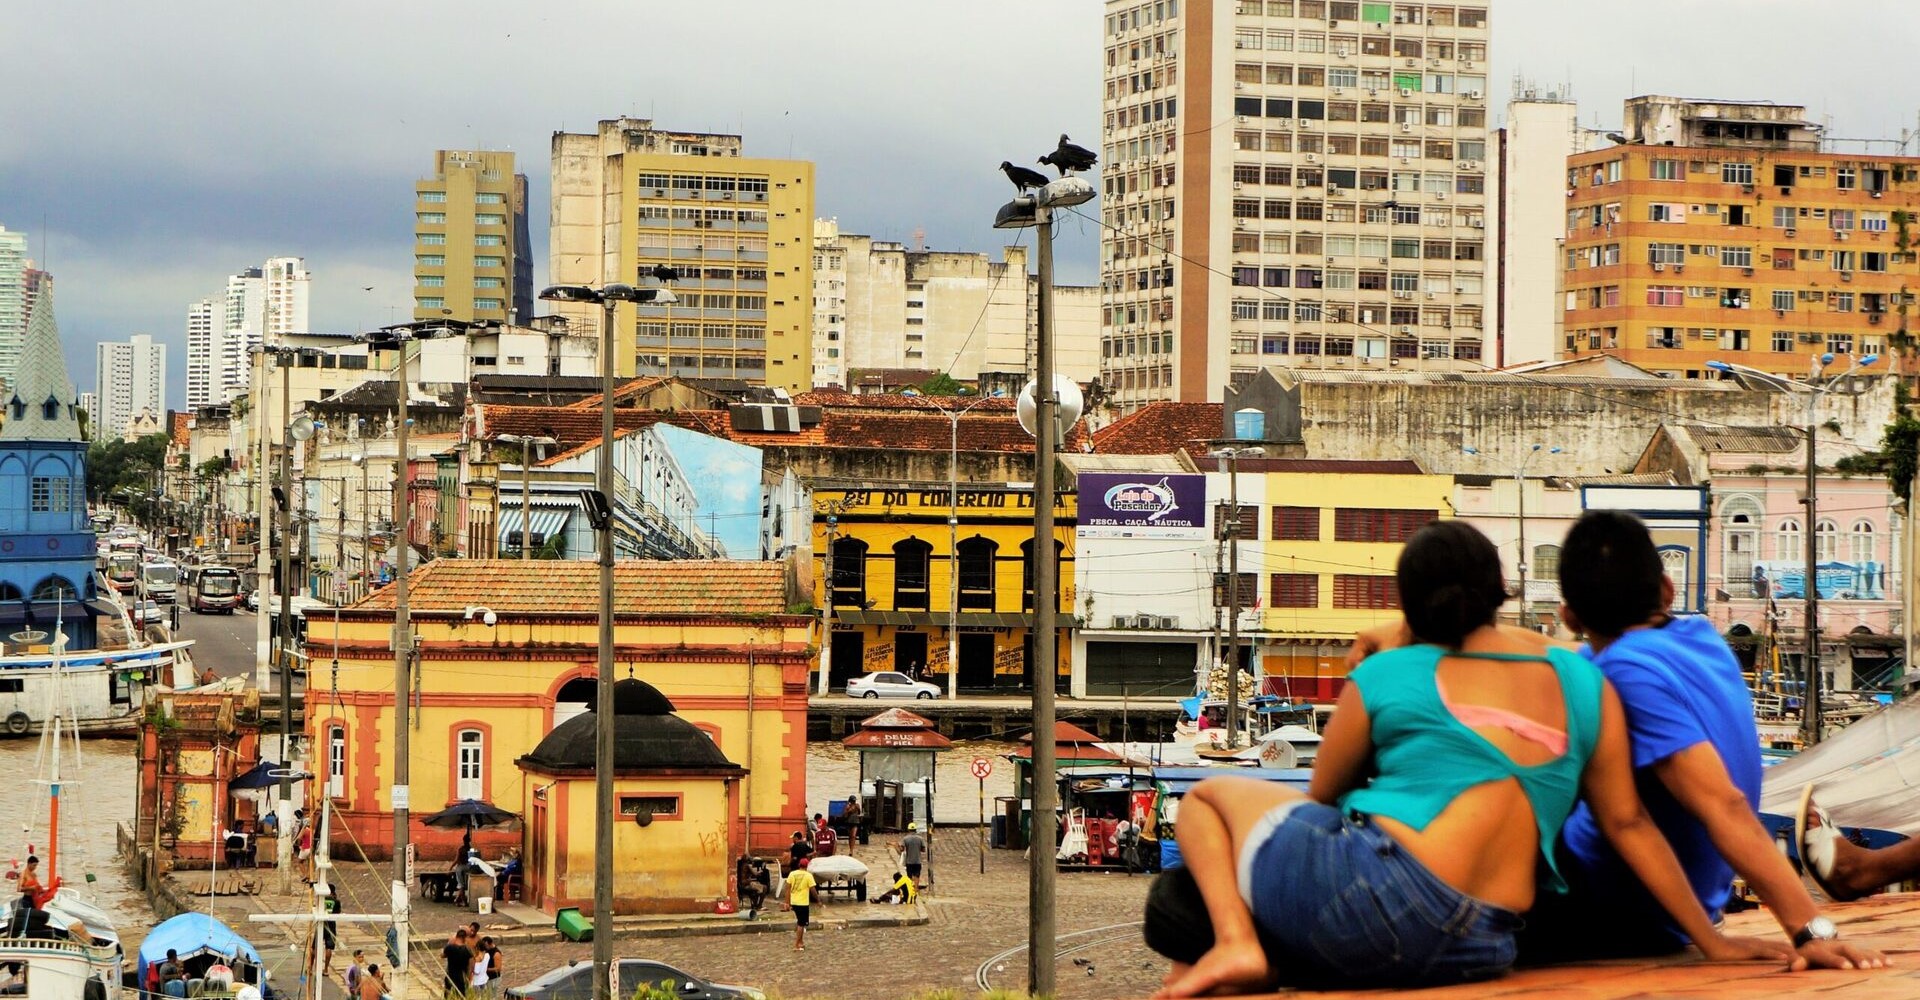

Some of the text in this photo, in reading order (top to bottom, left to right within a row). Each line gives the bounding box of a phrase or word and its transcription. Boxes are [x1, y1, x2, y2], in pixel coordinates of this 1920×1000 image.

[844, 491, 1065, 508] REI DO COMERCIO LTA
[1117, 490, 1154, 502] Loja do
[1114, 500, 1162, 511] Pescador
[1090, 518, 1118, 526] PESCA
[1124, 518, 1147, 527] CAÇA
[1154, 517, 1193, 527] NÁUTICA
[831, 622, 855, 631] REI
